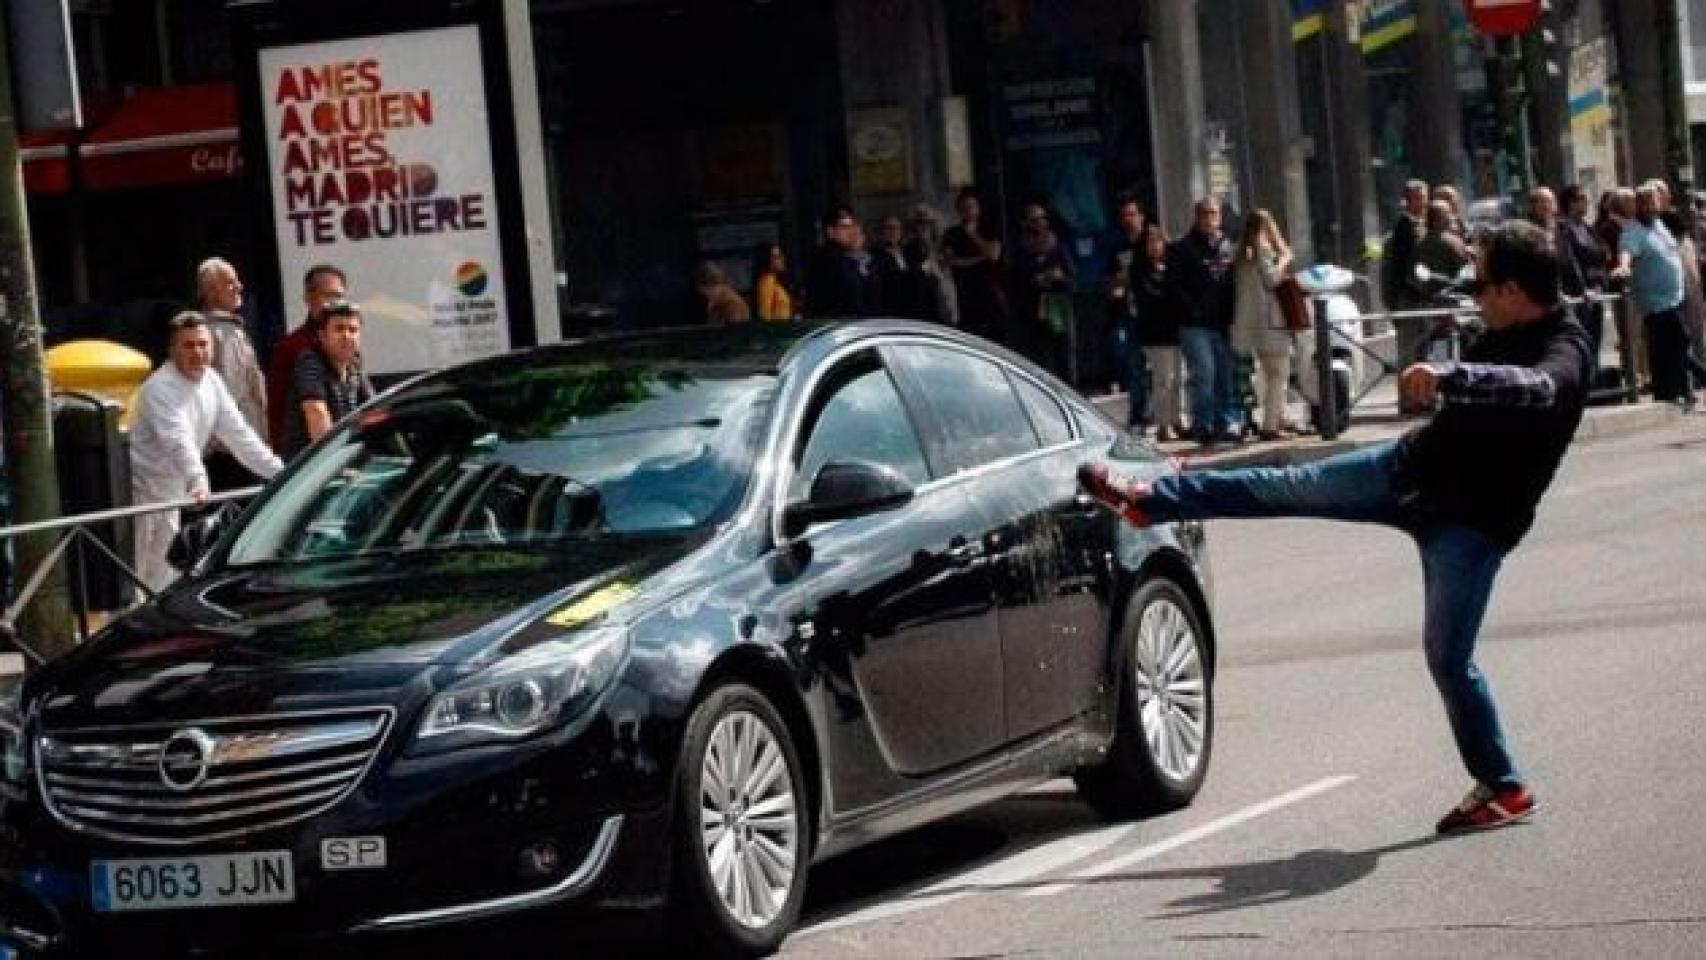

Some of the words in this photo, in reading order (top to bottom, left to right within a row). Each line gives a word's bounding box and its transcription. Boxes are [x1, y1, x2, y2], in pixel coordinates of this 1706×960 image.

[276, 59, 381, 104] AMES
[281, 105, 306, 139] A
[311, 89, 432, 134] QUIEN
[286, 165, 438, 210] MADRID
[288, 210, 336, 246] TE
[342, 195, 487, 241] QUIERE
[326, 840, 380, 866] SP
[114, 862, 202, 902] 6063
[216, 856, 286, 896] JJN
